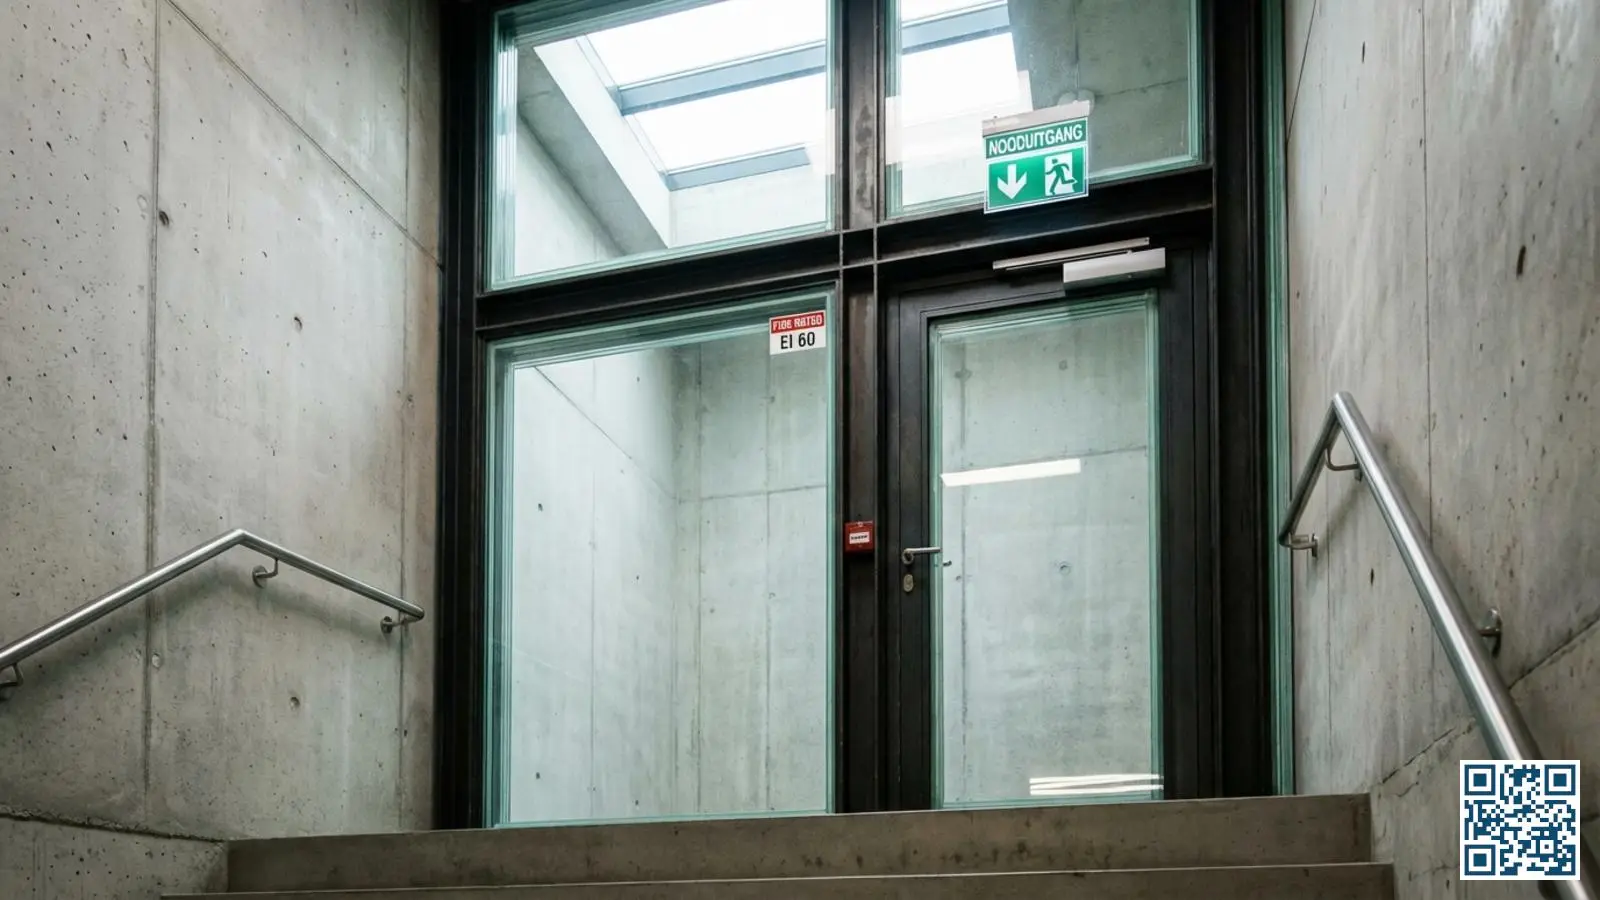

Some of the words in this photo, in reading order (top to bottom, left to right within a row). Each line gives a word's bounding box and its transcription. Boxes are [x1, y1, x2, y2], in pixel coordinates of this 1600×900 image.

[989, 124, 1083, 156] NOODUITGANG
[781, 334, 793, 350] EI
[798, 331, 815, 348] 60
